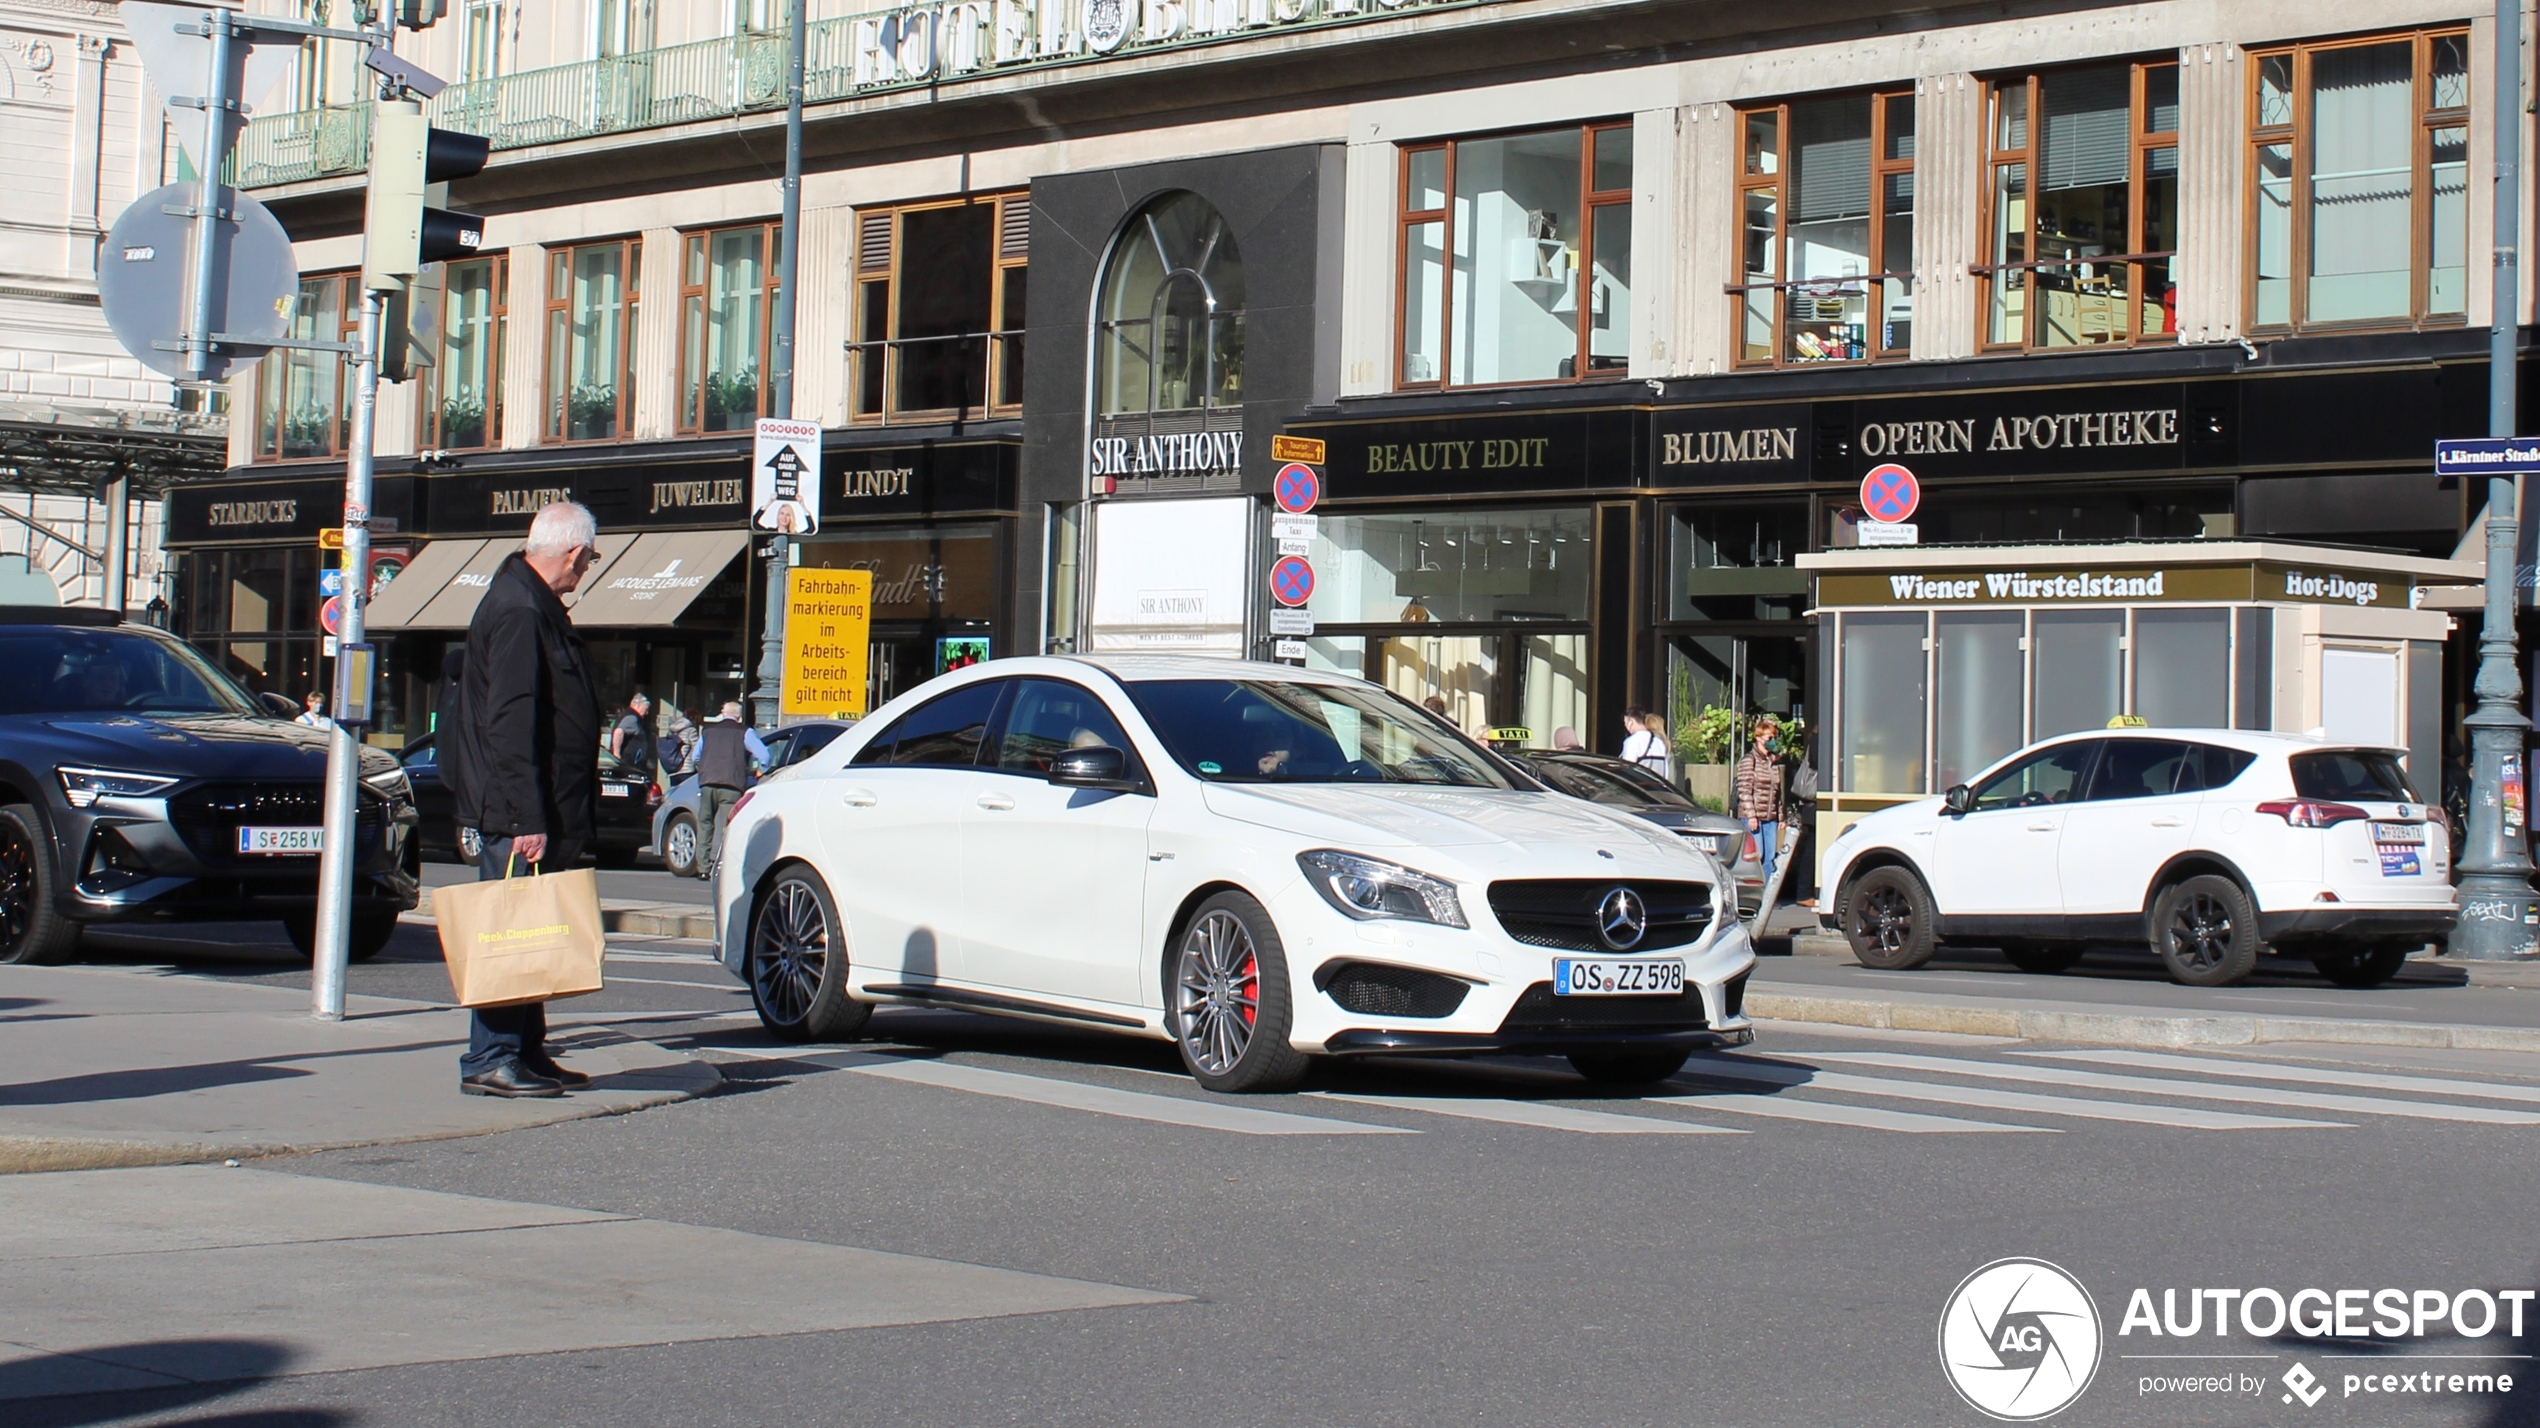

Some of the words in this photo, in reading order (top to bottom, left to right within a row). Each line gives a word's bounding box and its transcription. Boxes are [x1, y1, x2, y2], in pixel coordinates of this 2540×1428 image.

[851, 0, 1081, 86] HOTEL
[461, 230, 479, 245] 37
[1860, 419, 1976, 456] OPERN
[1986, 409, 2179, 450] APOTHEKE
[1092, 437, 1128, 475] SIR
[1134, 431, 1243, 473] ANTHONY
[1662, 427, 1797, 464] BLUMEN
[779, 453, 796, 463] AUF
[1367, 441, 1475, 473] BEAUTY
[1481, 438, 1549, 468] EDIT
[843, 468, 913, 497] LINDT
[650, 479, 743, 514] JUWELIER
[777, 486, 796, 496] WEG
[492, 488, 571, 515] PALMERS
[209, 500, 297, 525] STARBUCKS
[1289, 526, 1302, 535] Taxi
[1282, 542, 1307, 554] Anfang
[453, 574, 493, 587] PAL
[608, 575, 656, 590] JACQUES
[657, 575, 706, 589] LEMANS
[799, 579, 861, 596] Fahrbahn-
[1889, 575, 1980, 600] Wiener
[1985, 571, 2163, 598] Würstelstand
[2285, 571, 2378, 605] Hot-Dogs
[630, 592, 659, 600] STORE
[793, 600, 863, 620] markierung
[1140, 598, 1156, 613] SIR
[1159, 597, 1205, 613] ANTHONY
[820, 622, 835, 637] im
[801, 643, 850, 659] Arbeits-
[1282, 644, 1301, 655] Ende
[802, 665, 847, 681] bereich
[796, 687, 817, 704] gilt
[821, 686, 852, 702] nicht
[839, 712, 861, 721] TAXI
[2122, 715, 2145, 727] TAXI
[1502, 730, 1526, 739] TAXI
[280, 831, 308, 848] 258
[311, 831, 324, 848] V
[1572, 964, 1602, 990] OS
[1617, 964, 1644, 990] ZZ
[1648, 964, 1681, 990] 598
